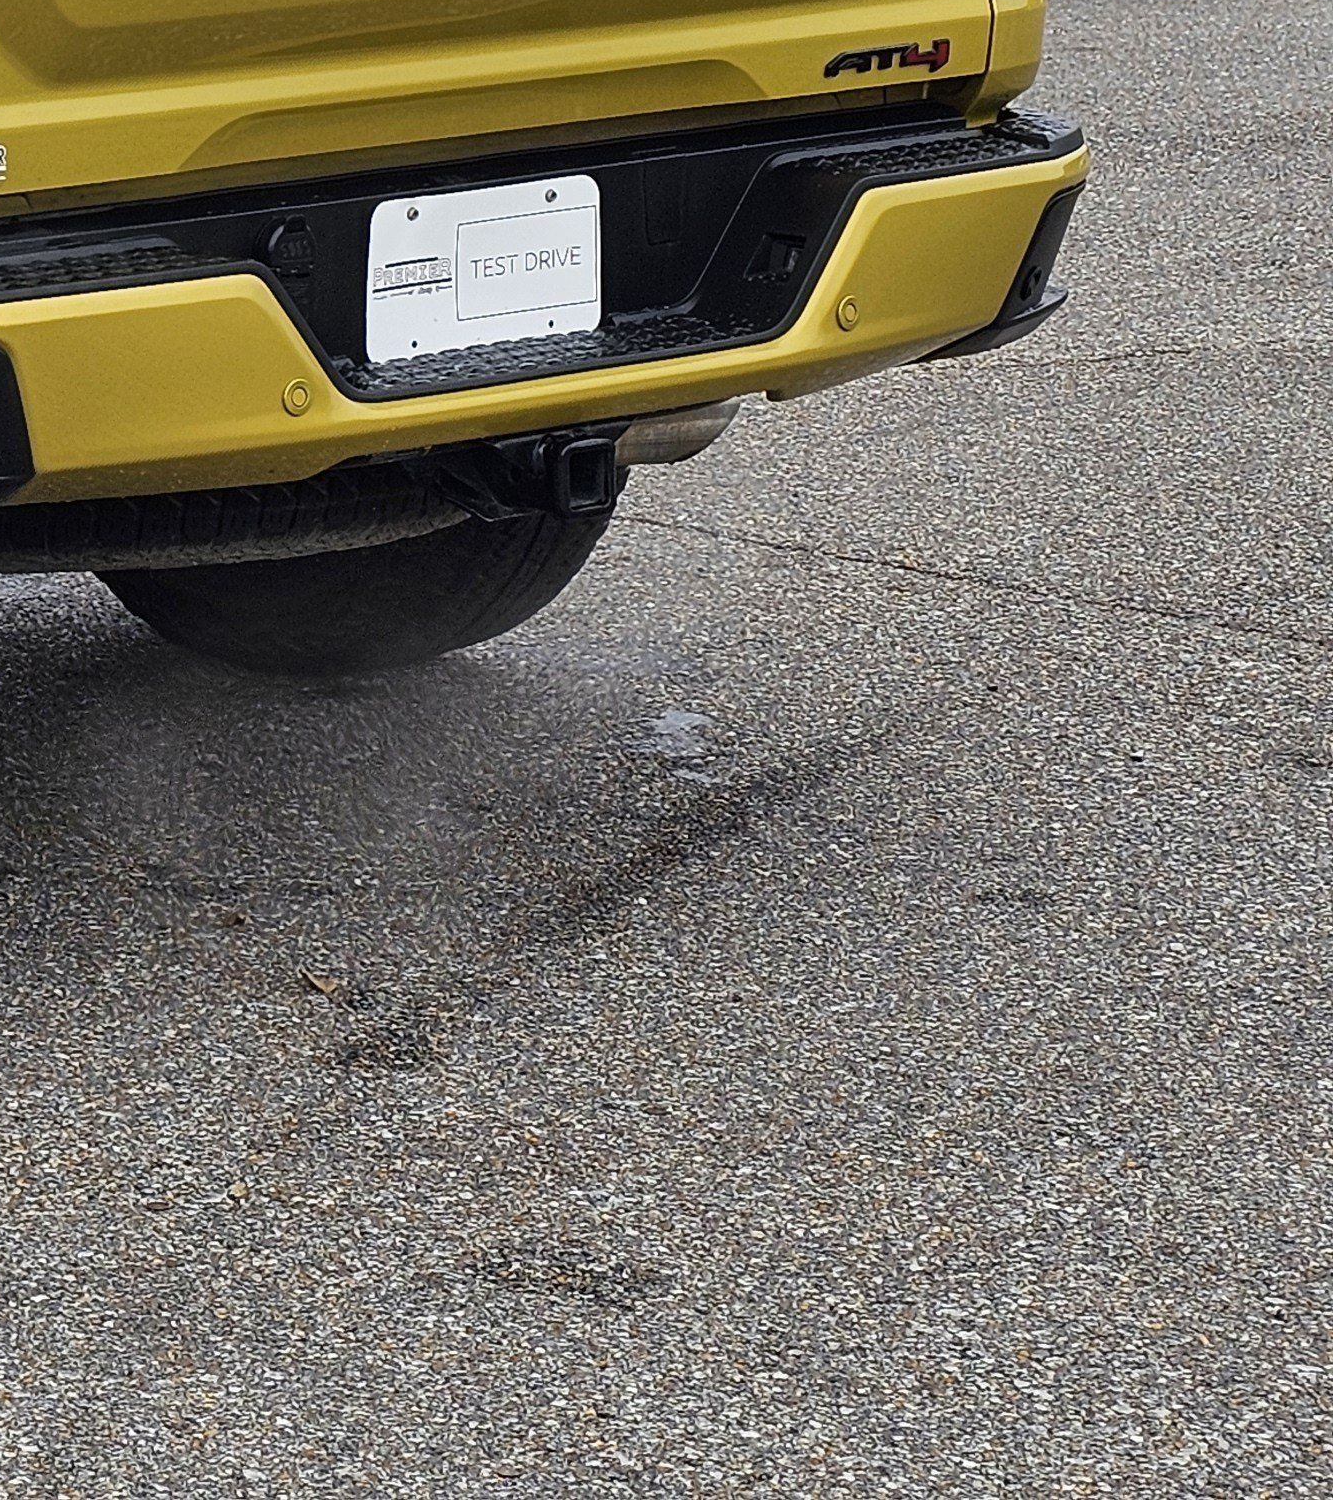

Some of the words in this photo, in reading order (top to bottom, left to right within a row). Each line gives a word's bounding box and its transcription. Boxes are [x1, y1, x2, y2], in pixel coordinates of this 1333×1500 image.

[823, 38, 951, 79] AT4
[373, 257, 452, 288] PREMIER
[470, 254, 519, 280] TEST
[525, 245, 582, 272] DRIVE
